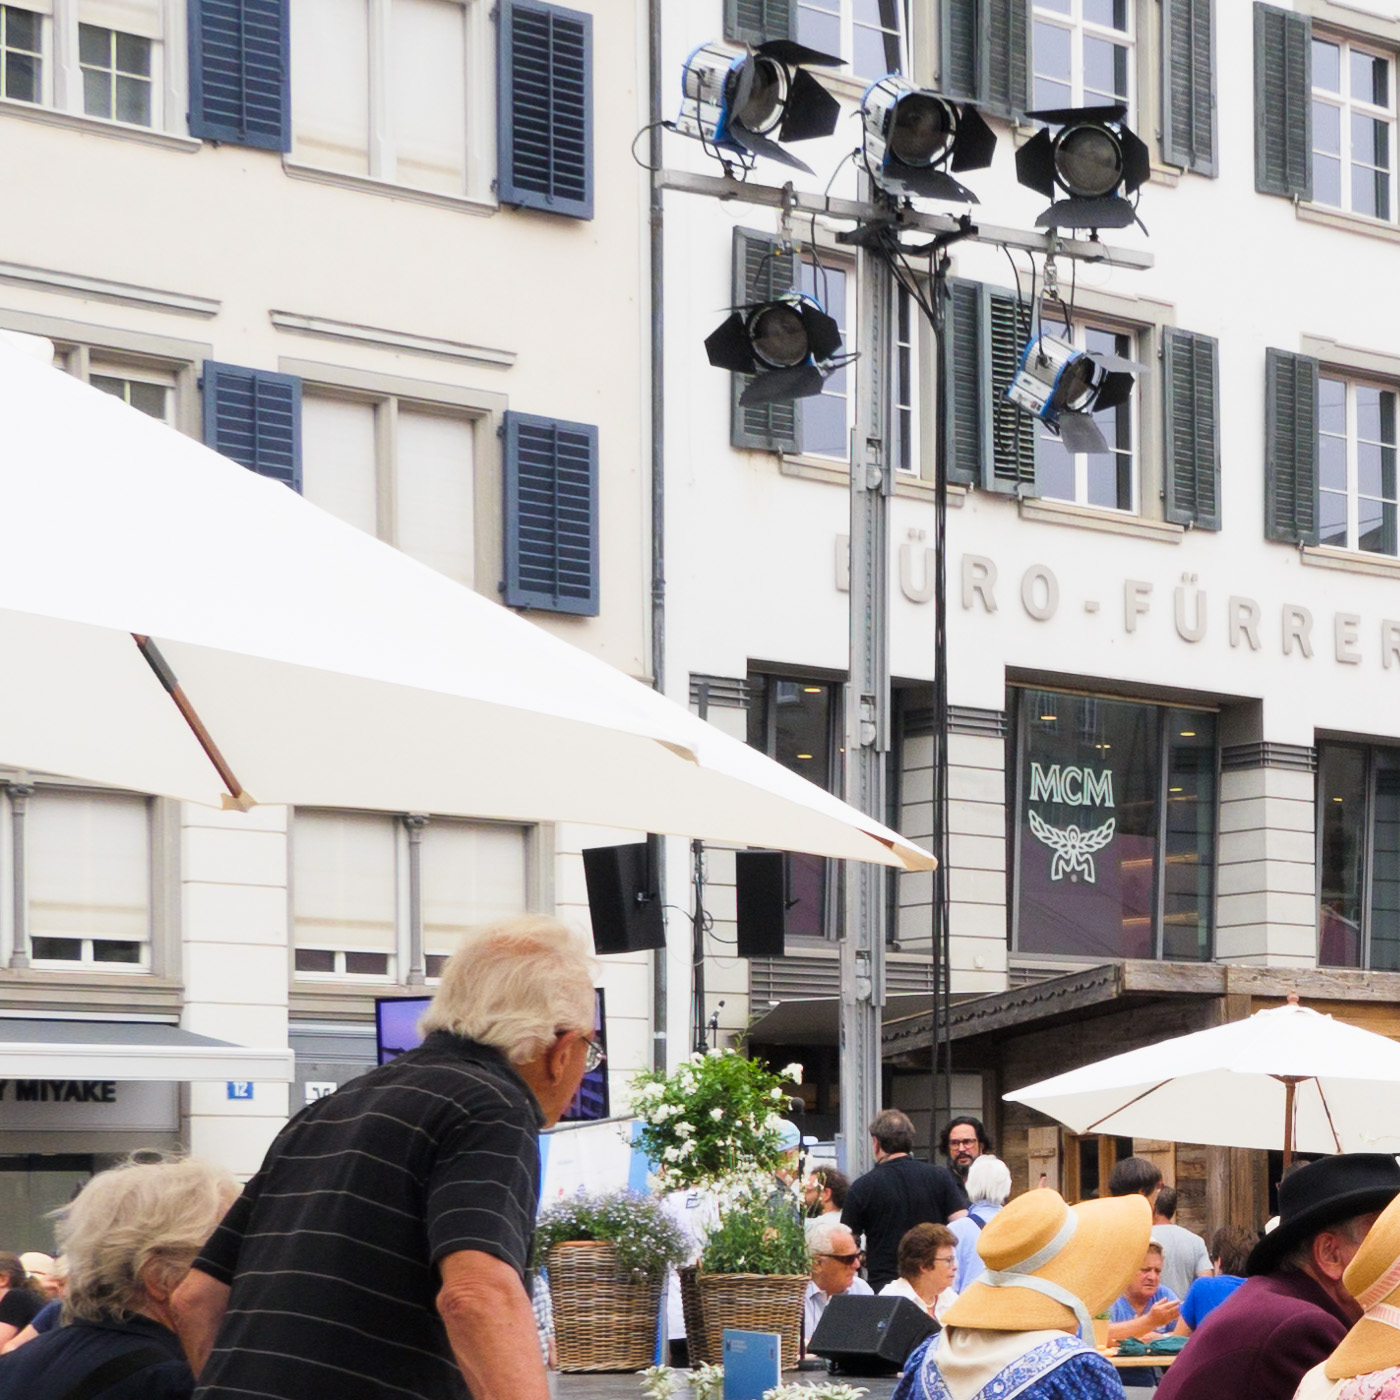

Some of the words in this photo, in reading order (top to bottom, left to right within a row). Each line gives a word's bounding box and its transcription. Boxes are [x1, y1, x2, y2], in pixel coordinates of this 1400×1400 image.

[1029, 762, 1115, 807] MCM
[15, 1080, 117, 1102] MIYAKE
[233, 1081, 249, 1097] 12
